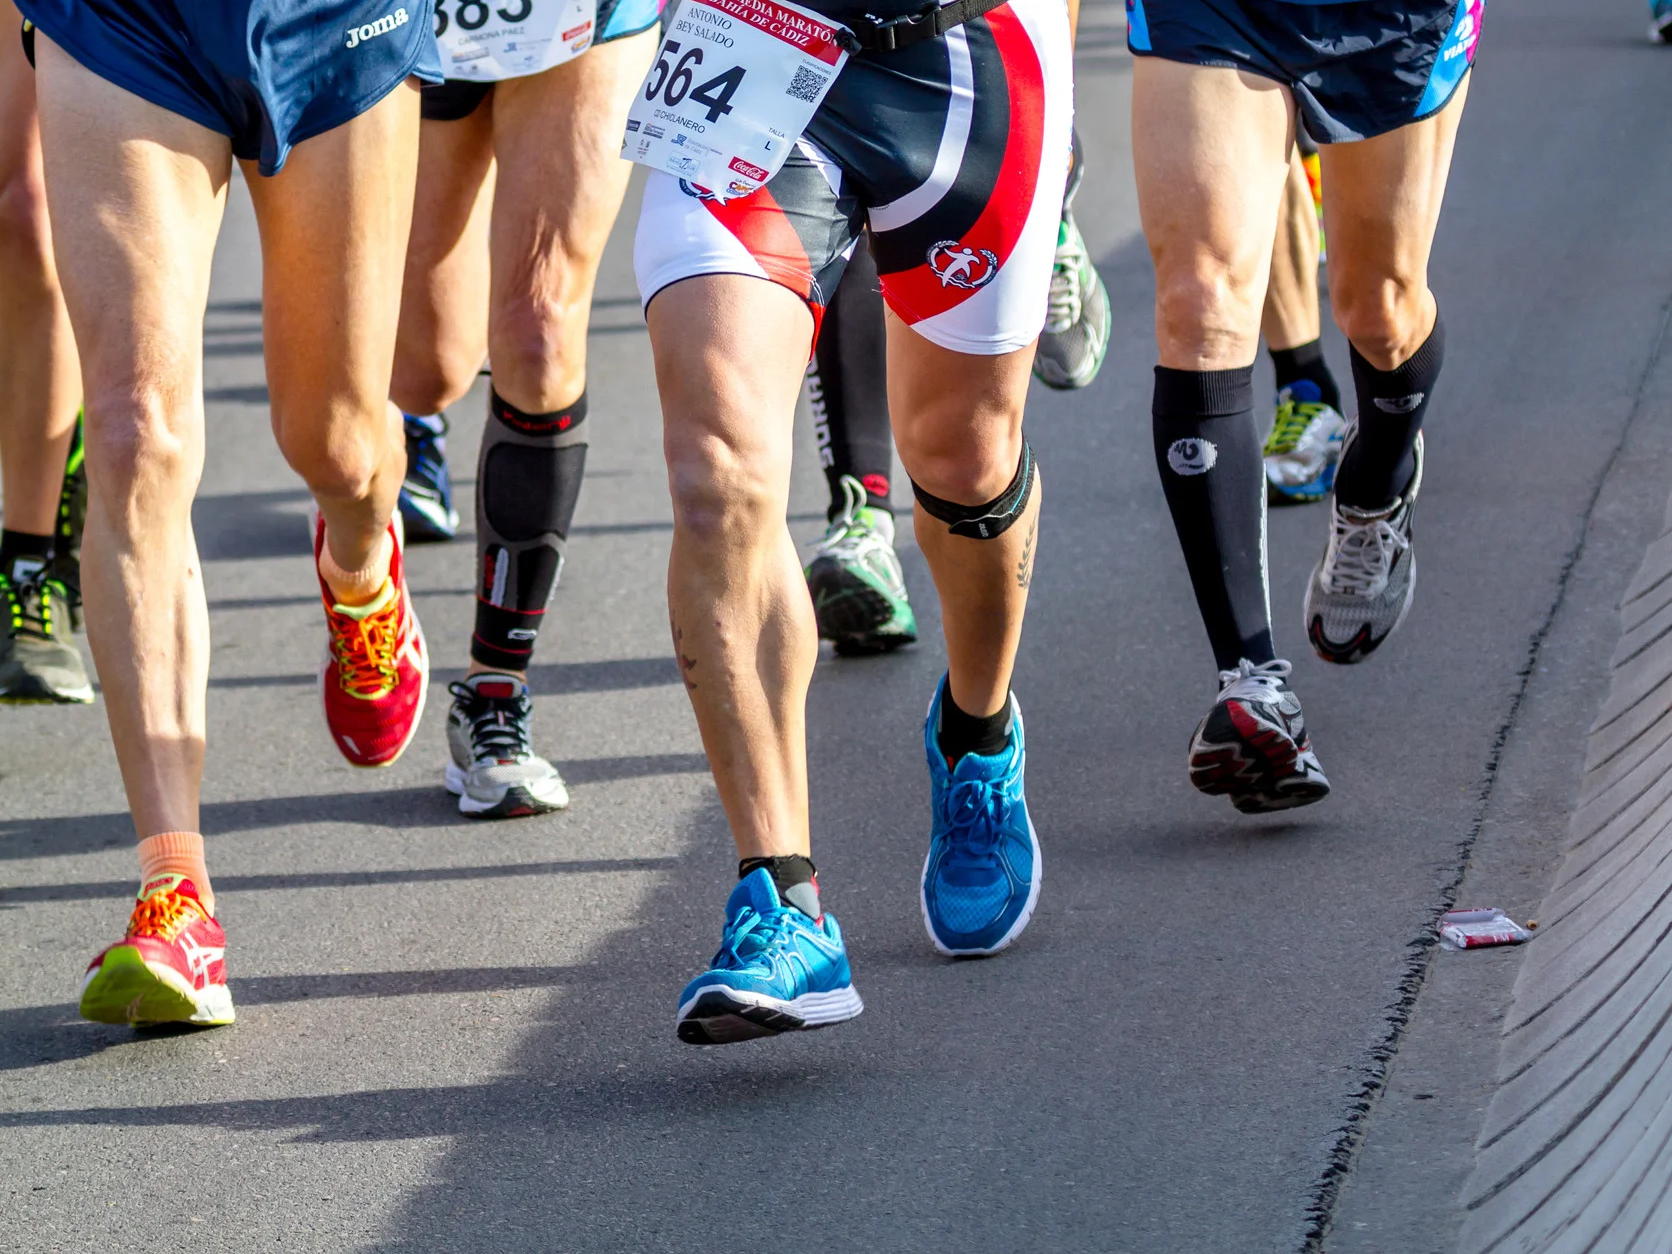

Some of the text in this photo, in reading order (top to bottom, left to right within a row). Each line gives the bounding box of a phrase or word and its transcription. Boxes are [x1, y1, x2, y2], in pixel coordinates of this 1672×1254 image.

[346, 8, 409, 48] Joma
[688, 7, 732, 30] ANTONIO
[750, 13, 770, 27] DE
[770, 22, 810, 46] CÁDIZ
[458, 26, 525, 45] CARMONA PAEZ
[676, 19, 734, 48] BEY SALADO
[645, 39, 747, 124] 564
[660, 110, 706, 134] CHICLANERO
[769, 127, 785, 138] TALLA
[764, 140, 771, 151] L
